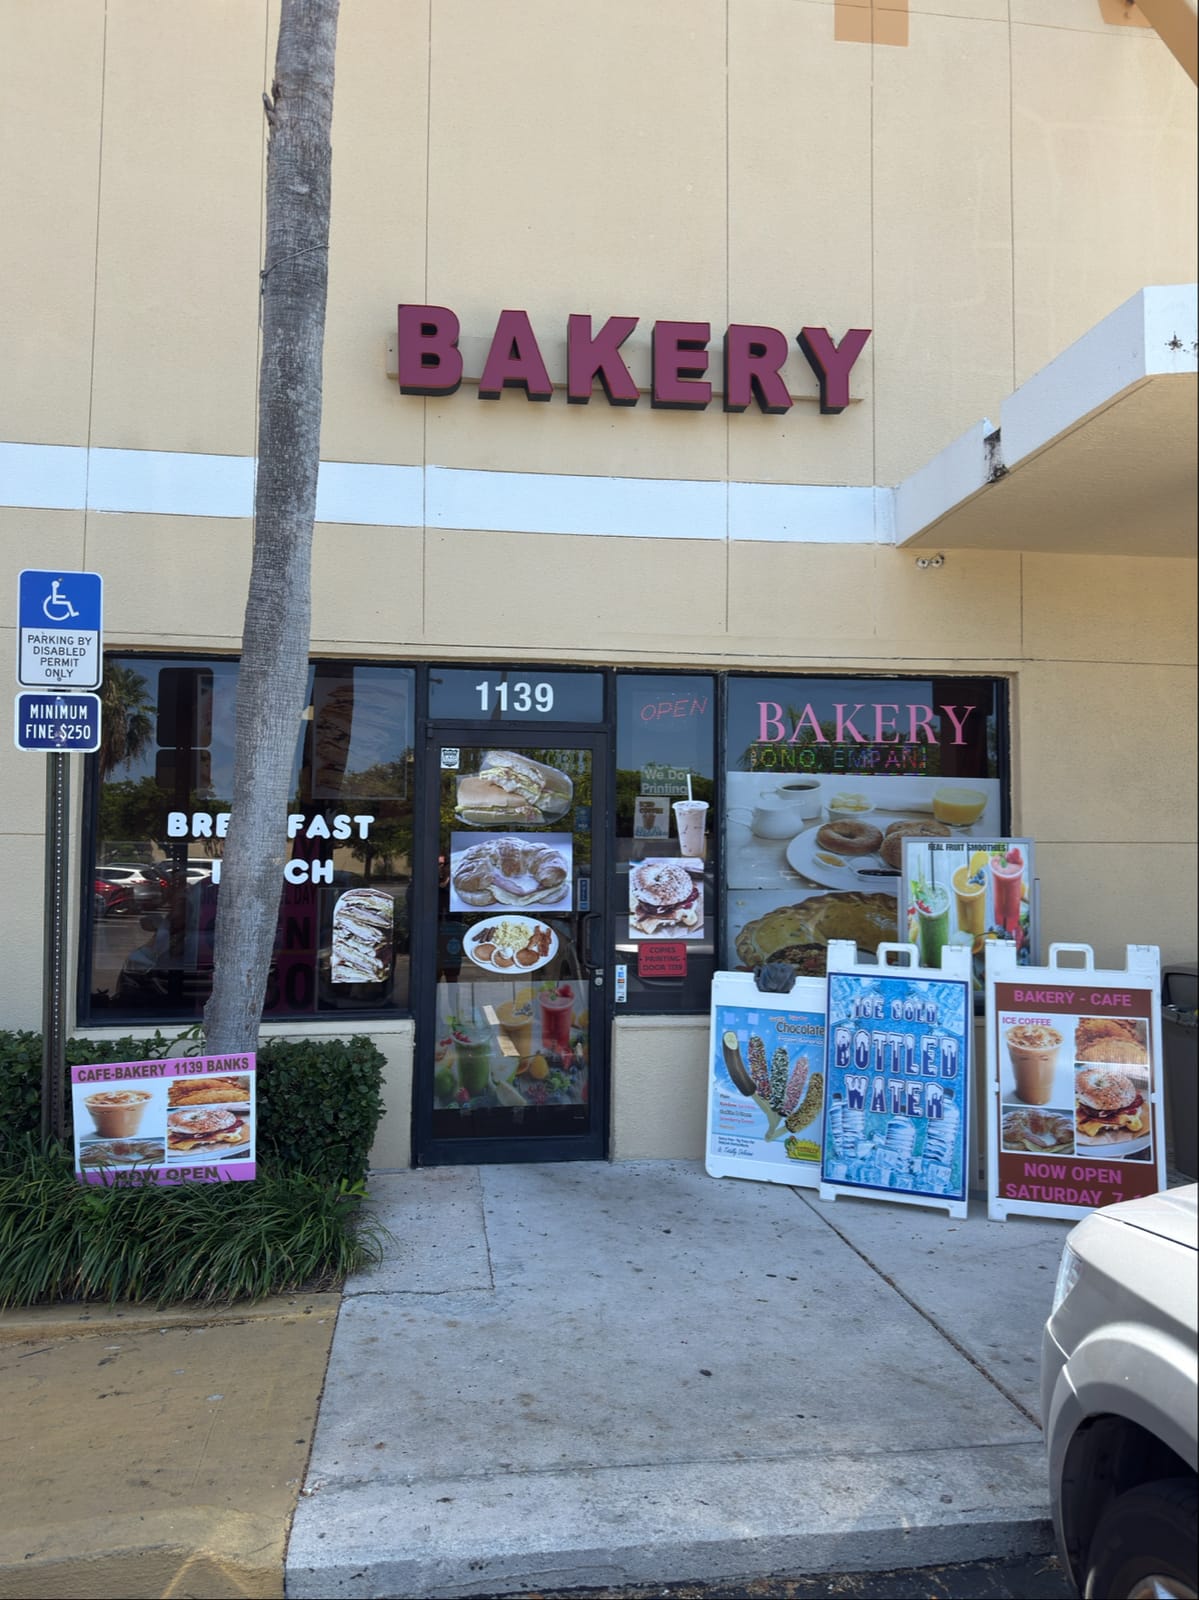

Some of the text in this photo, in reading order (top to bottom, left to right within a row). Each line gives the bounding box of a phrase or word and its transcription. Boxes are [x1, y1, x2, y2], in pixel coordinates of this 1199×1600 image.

[398, 304, 872, 413] BAKERY
[27, 634, 92, 646] PARKING BY
[33, 646, 86, 657] DISABLED
[40, 657, 79, 667] PERMIT
[45, 668, 74, 678] ONLY
[475, 681, 554, 712] 1139
[30, 704, 88, 720] MINIMUM
[640, 697, 708, 720] OPEN
[25, 723, 91, 740] FINE $250
[757, 702, 976, 745] BAKERY
[645, 769, 685, 780] We Do
[167, 812, 375, 840] BREFAST
[946, 843, 964, 851] FRUIT
[1013, 990, 1076, 1005] BAKERY
[1090, 993, 1132, 1007] CAFE
[853, 998, 938, 1024] ICE COLD
[776, 1021, 825, 1037] Chocolate
[1002, 1017, 1052, 1026] ICE COFFEE
[835, 1027, 958, 1079] BOTTLED
[77, 1057, 249, 1082] CAFE-BAKERY 1139 BANKS
[844, 1074, 944, 1120] WATER
[166, 1167, 219, 1181] OPEN
[1023, 1162, 1122, 1184] NOW OPEN
[1005, 1183, 1103, 1205] SATURDAY
